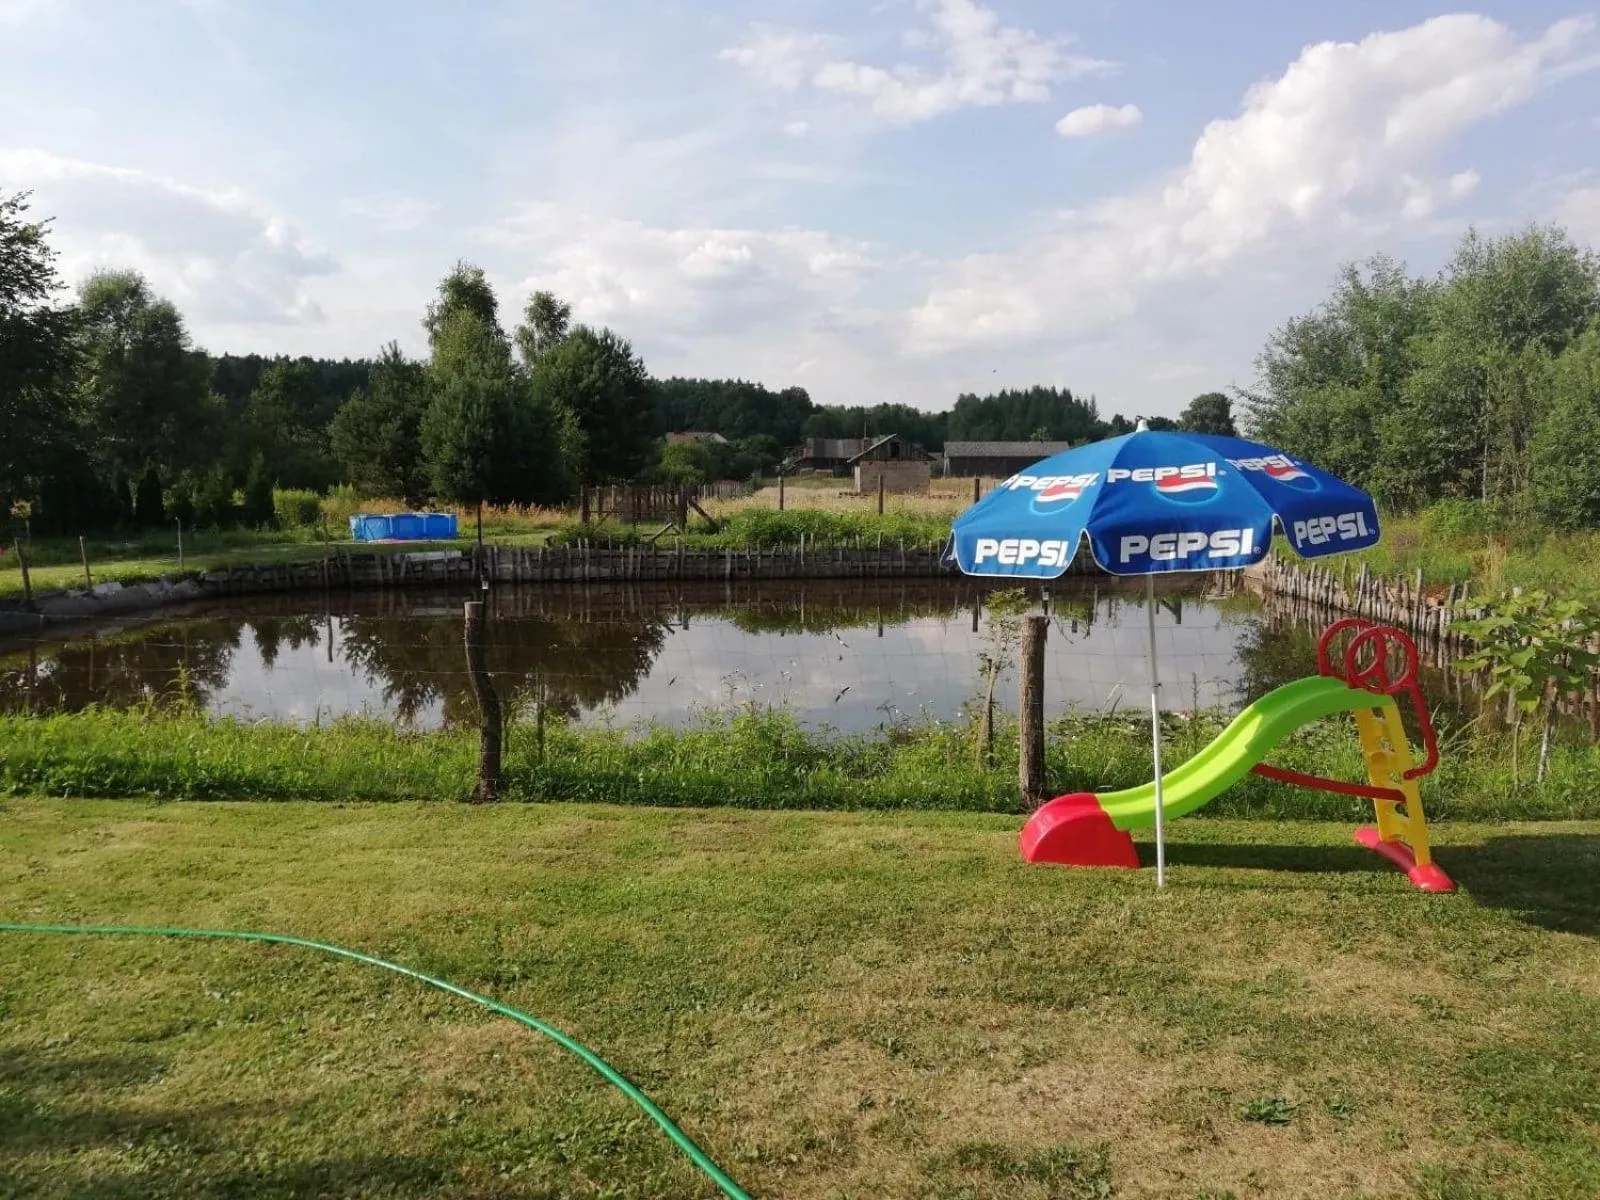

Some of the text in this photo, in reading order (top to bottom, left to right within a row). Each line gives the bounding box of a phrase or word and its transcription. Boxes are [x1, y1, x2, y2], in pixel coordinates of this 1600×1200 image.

[1107, 463, 1216, 483] PEPSI
[1225, 454, 1296, 471] PEPSI
[1009, 473, 1100, 490] PEPSI
[1294, 511, 1368, 548] PEPSI
[975, 539, 1069, 567] PEPSI
[1120, 528, 1253, 563] PEPSI
